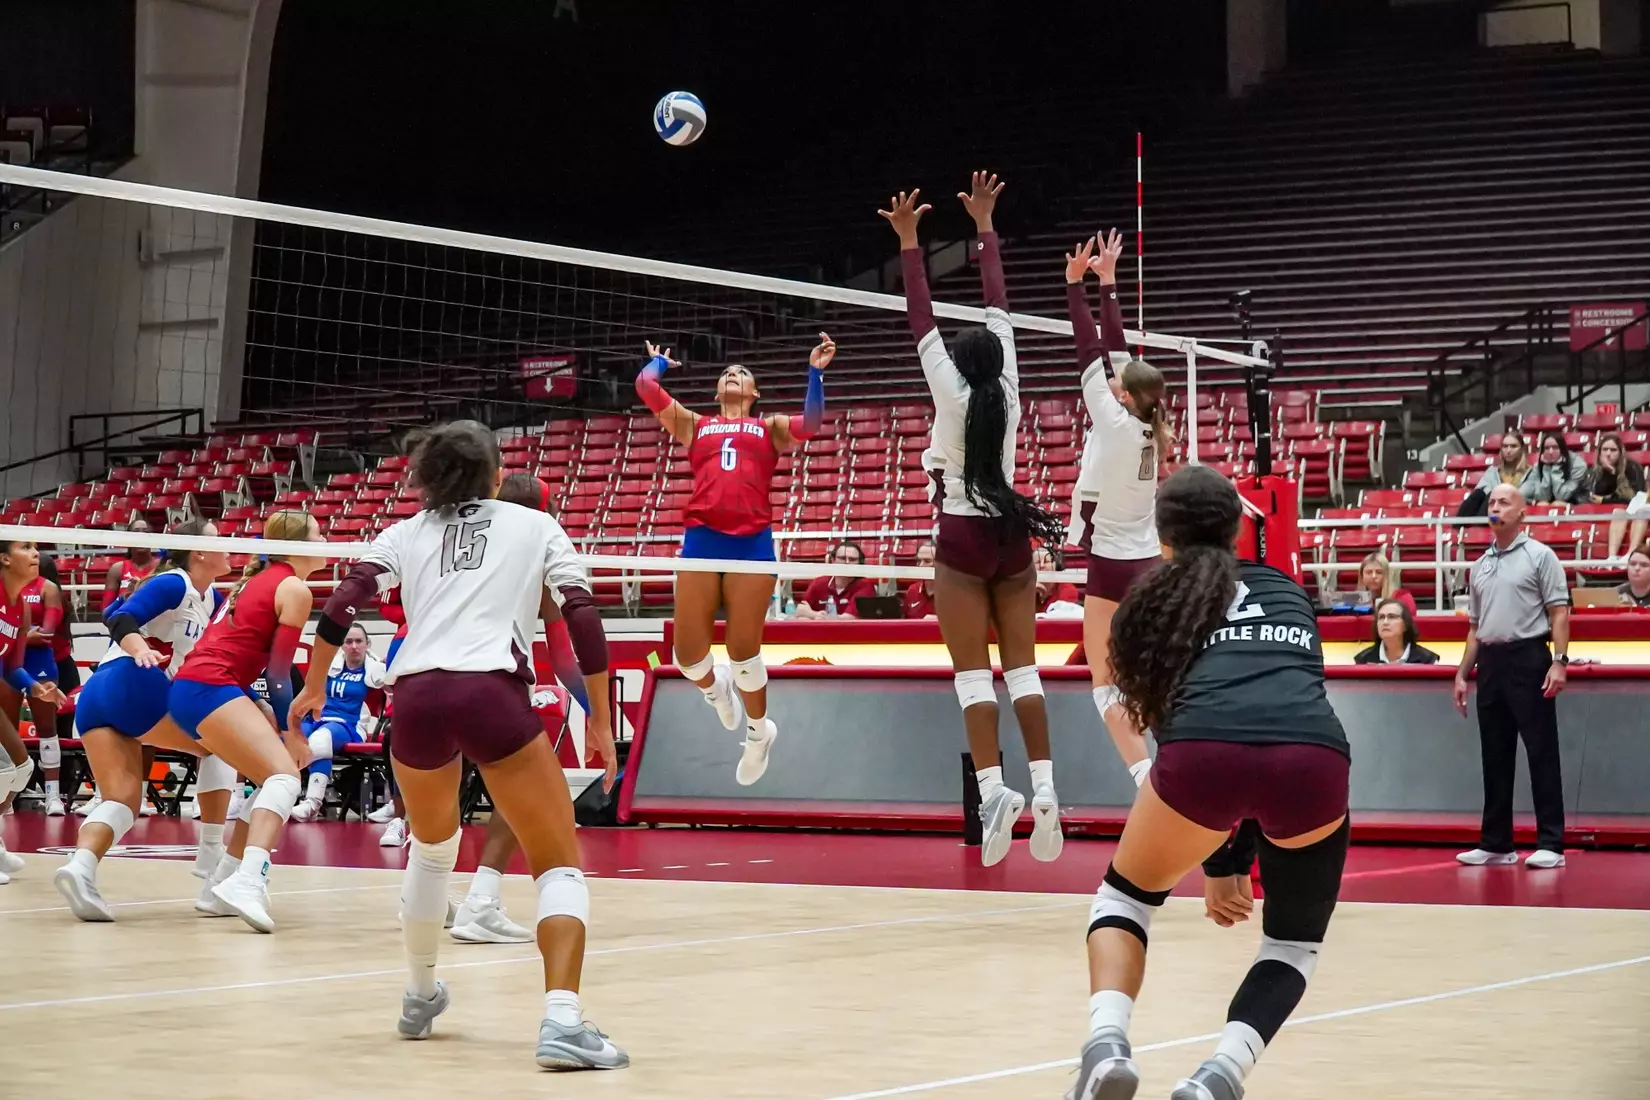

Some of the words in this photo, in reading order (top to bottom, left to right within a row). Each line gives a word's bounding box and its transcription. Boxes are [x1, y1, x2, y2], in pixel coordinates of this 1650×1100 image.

[1582, 309, 1633, 318] RESTROOMS
[743, 422, 764, 438] TECH
[721, 437, 737, 472] 6
[1407, 449, 1418, 460] 13
[440, 519, 492, 577] 15
[1260, 624, 1313, 650] ROCK
[330, 680, 346, 698] 14
[28, 725, 36, 737] G
